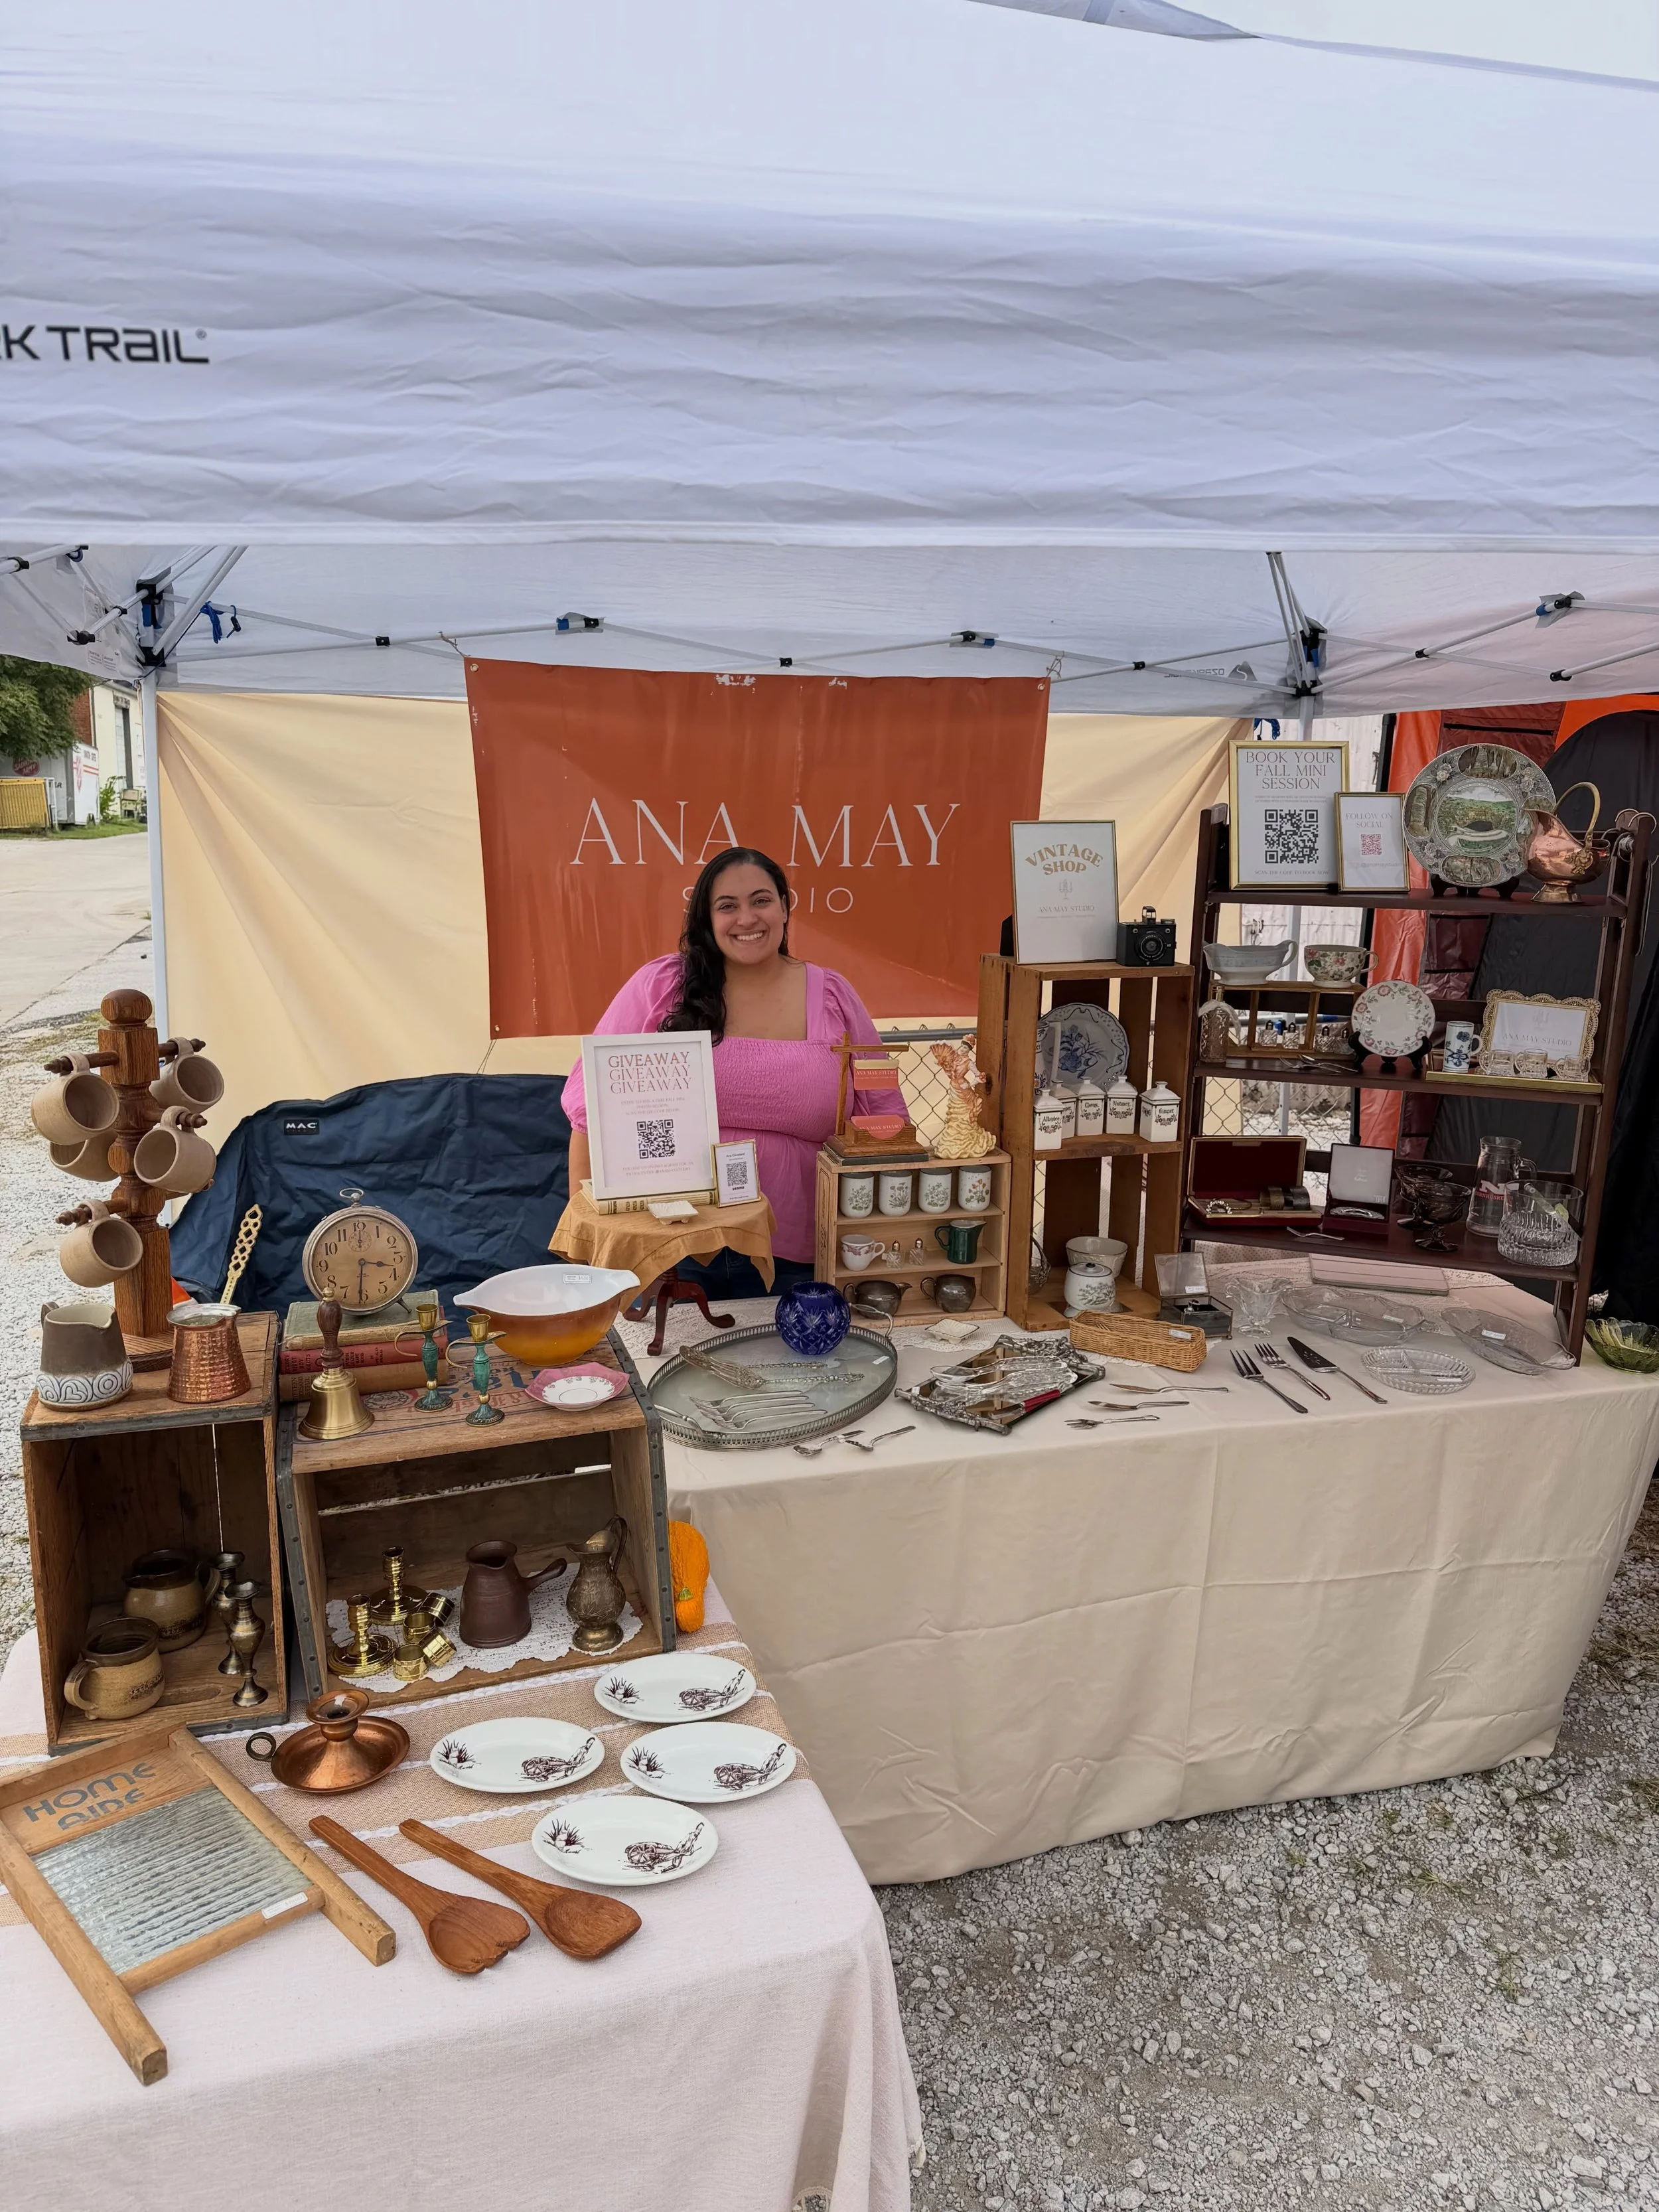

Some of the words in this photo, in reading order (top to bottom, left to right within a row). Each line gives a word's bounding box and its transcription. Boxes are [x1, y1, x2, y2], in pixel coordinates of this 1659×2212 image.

[0, 324, 40, 361] K
[1246, 751, 1287, 763] BOOK
[1294, 751, 1335, 763] YOUR
[1256, 765, 1290, 776] FALL
[1296, 765, 1326, 776] MINI
[1262, 777, 1320, 789] SESSION
[572, 797, 740, 865] ANA
[786, 803, 960, 867] MAY
[1025, 844, 1103, 867] VINTAGE
[1043, 860, 1087, 875] SHOP
[608, 1051, 690, 1068] GIVEAWAY
[609, 1065, 691, 1081] GIVEAWAY
[611, 1077, 691, 1094] GIVEAWAY
[325, 1242, 338, 1256] 10
[387, 1236, 397, 1249] 2
[319, 1259, 328, 1272] 9
[327, 1275, 336, 1289] 8
[378, 1281, 388, 1294] 5
[340, 1285, 350, 1299] 7
[23, 1762, 156, 1822] HOME
